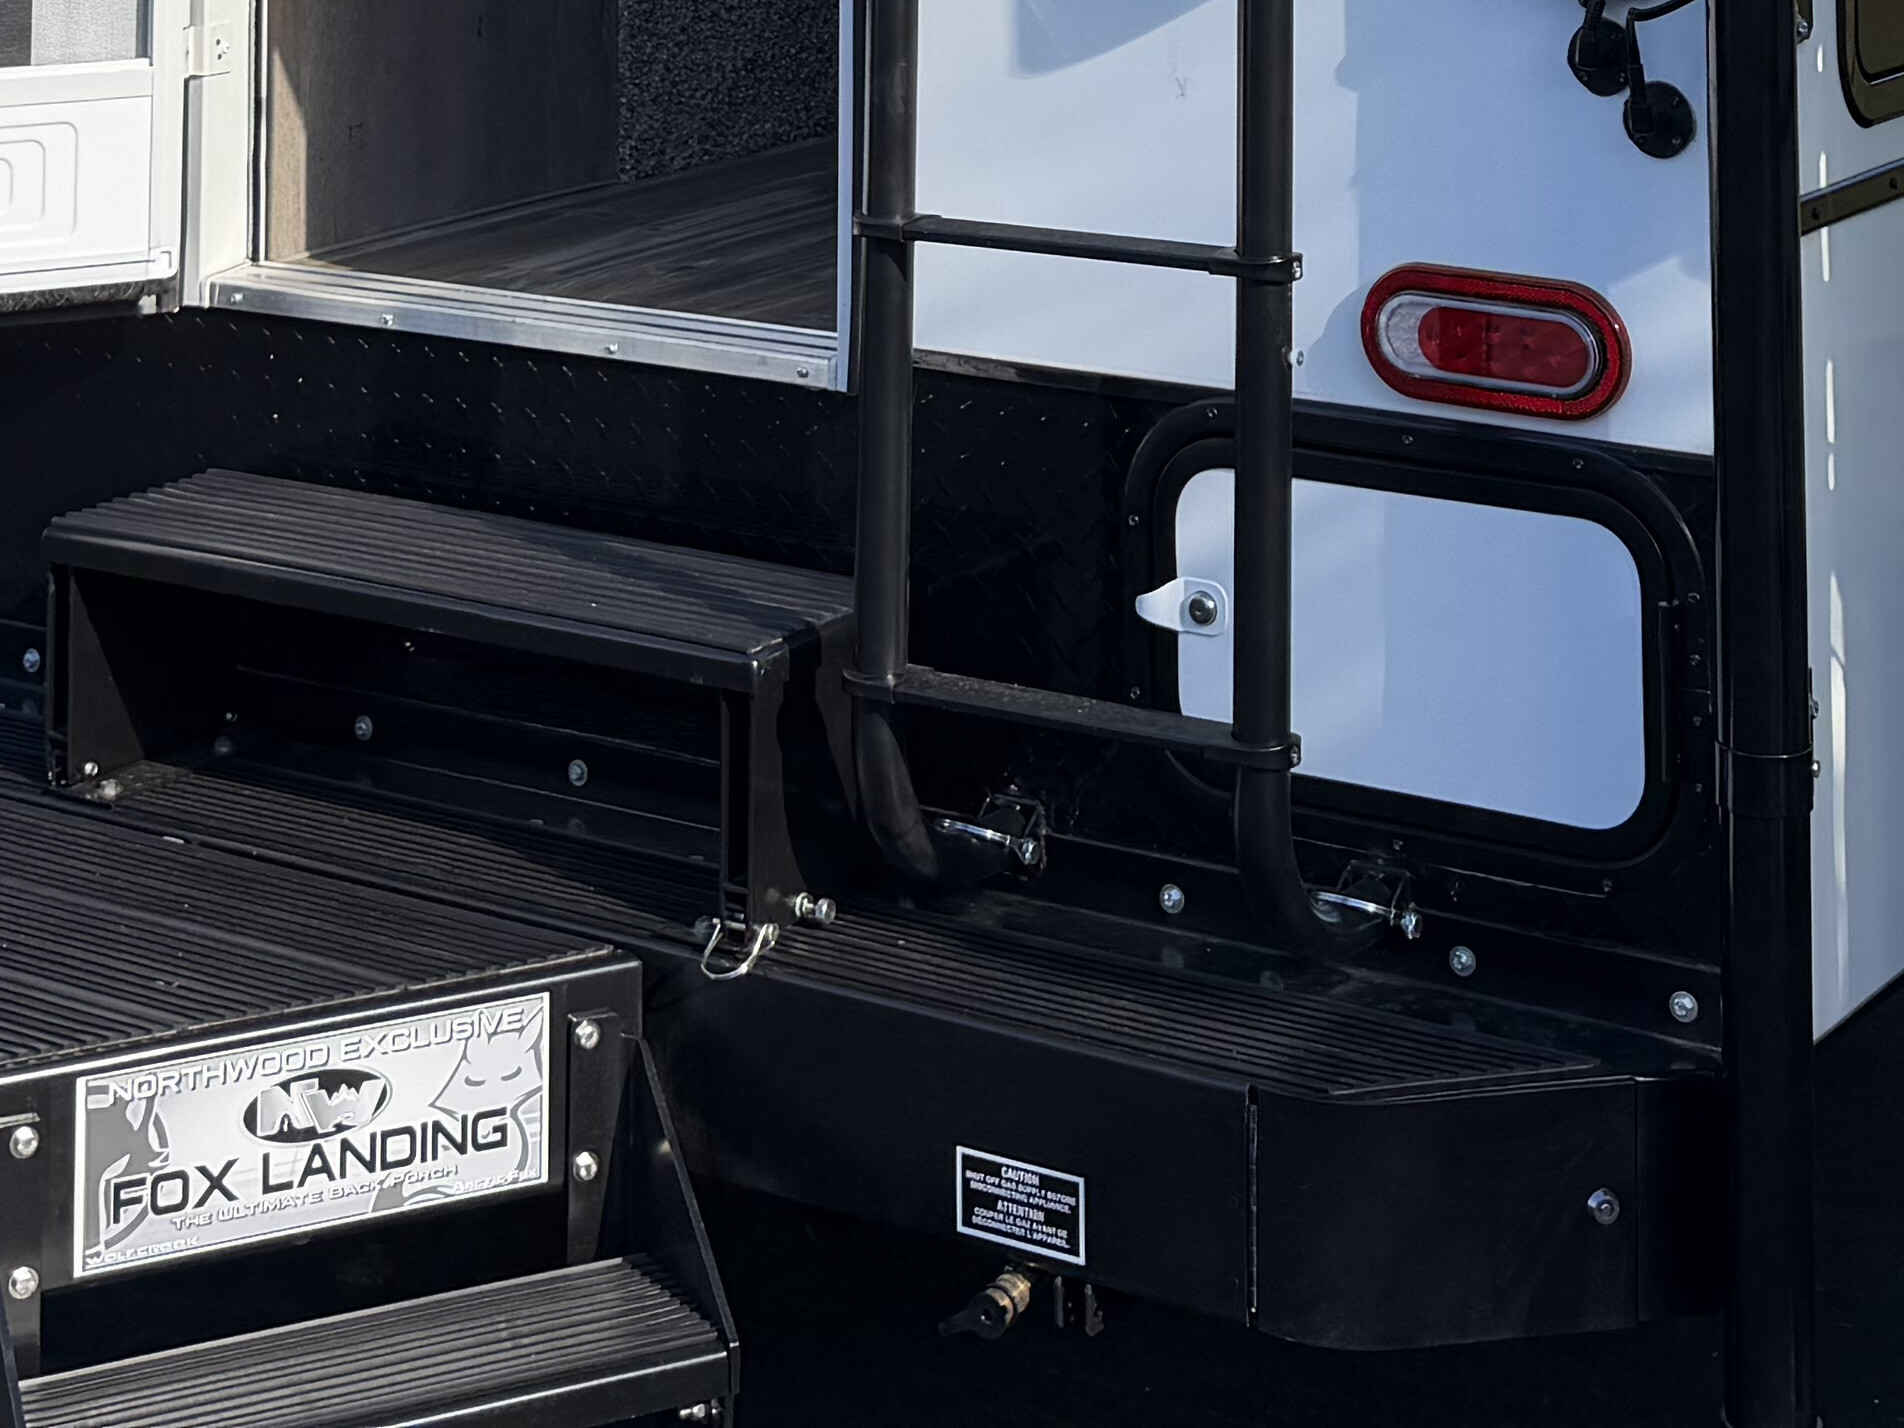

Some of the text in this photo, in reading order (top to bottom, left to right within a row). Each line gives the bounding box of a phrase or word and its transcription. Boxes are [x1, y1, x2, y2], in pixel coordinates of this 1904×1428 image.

[108, 1008, 525, 1106] NORTHWOOD EXCLUSIVE
[112, 1106, 508, 1225] FOX LANDING
[171, 1165, 458, 1231] THE ULTIMATE BACK PORCH
